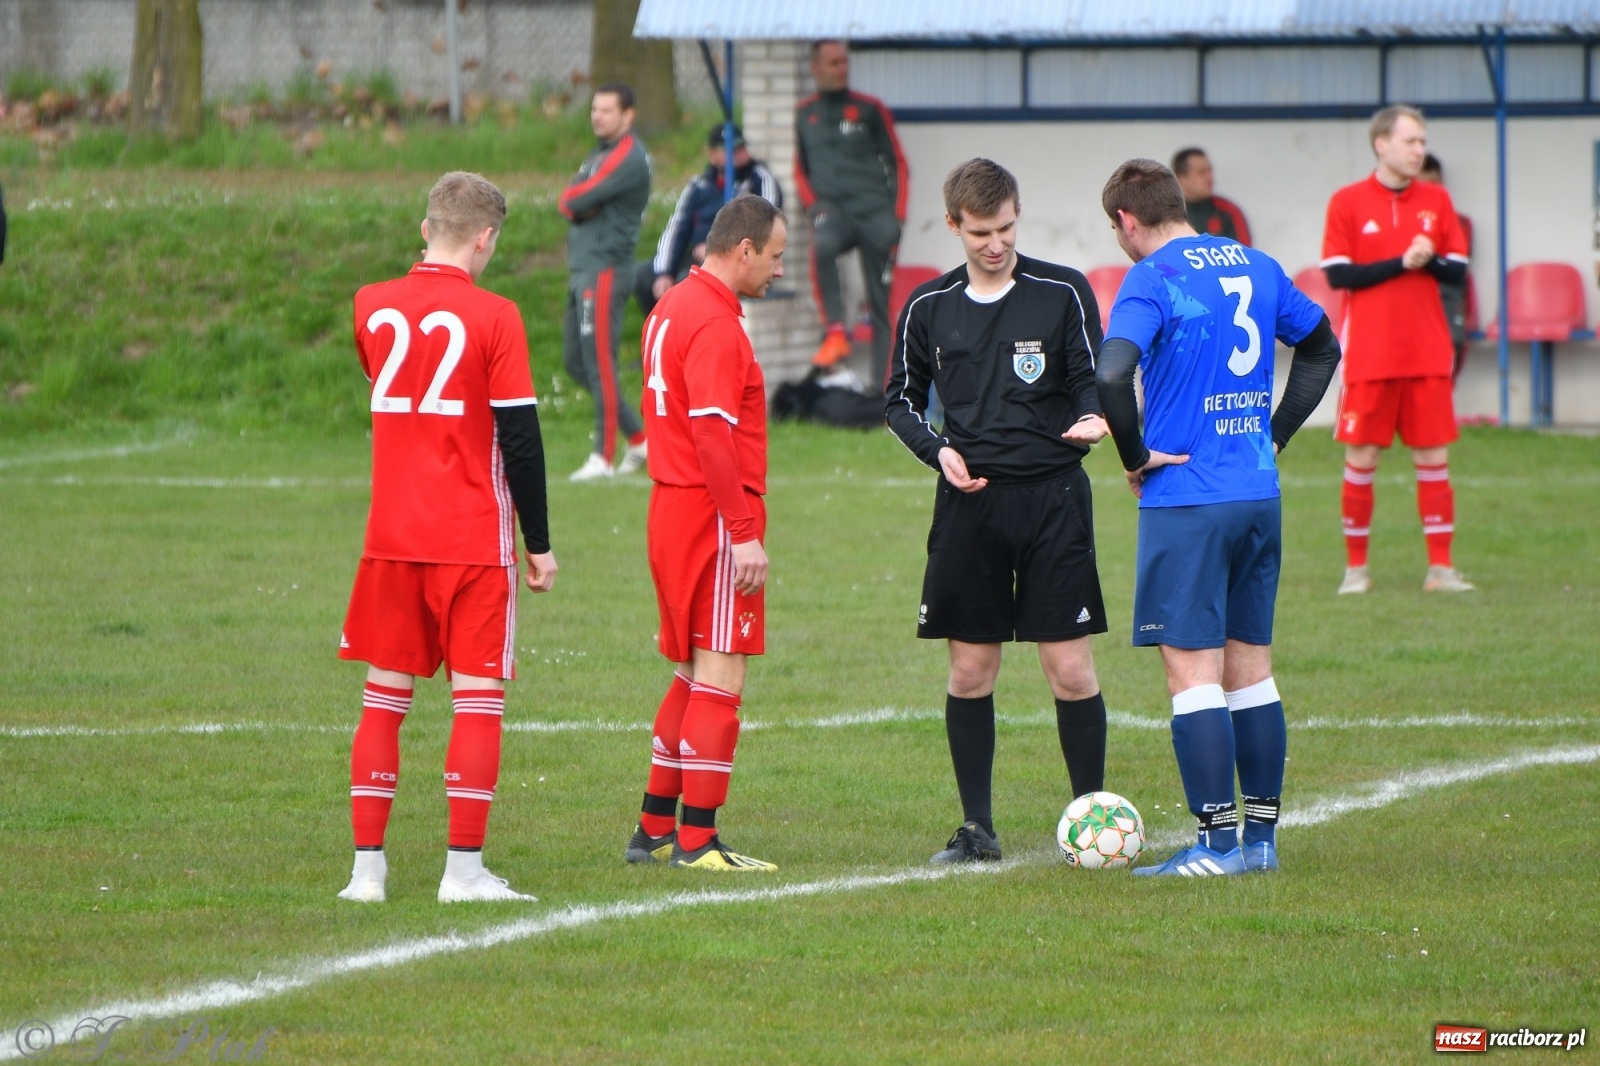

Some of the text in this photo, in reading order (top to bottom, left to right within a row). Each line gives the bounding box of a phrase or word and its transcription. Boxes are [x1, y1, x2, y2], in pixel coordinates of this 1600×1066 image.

[1183, 244, 1250, 270] START
[1218, 275, 1261, 377] 3
[366, 308, 466, 416] 22
[371, 771, 397, 782] FCB
